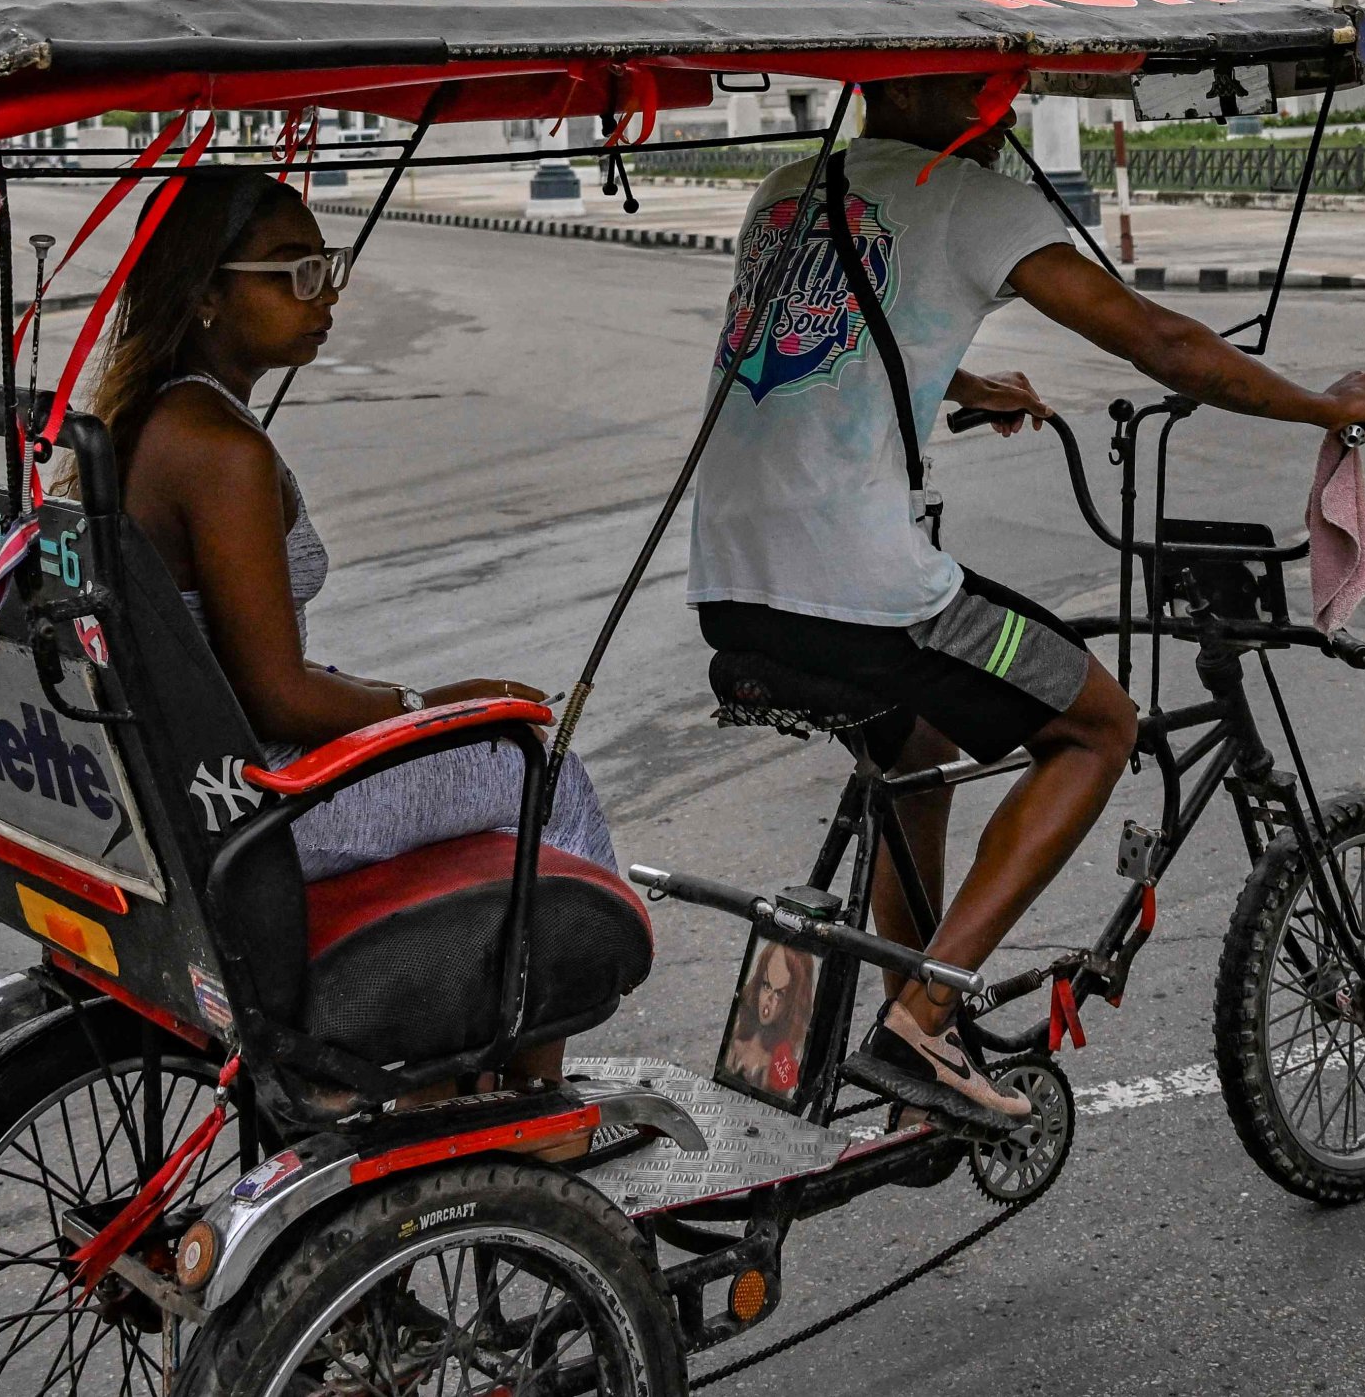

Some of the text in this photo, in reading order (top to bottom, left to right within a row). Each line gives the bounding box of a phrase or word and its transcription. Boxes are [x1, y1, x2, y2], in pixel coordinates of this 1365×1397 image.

[809, 278, 848, 309] the
[772, 292, 844, 338] Soul
[775, 1061, 789, 1084] AMO
[782, 1056, 792, 1073] TE
[419, 1202, 478, 1230] WORCRAFT
